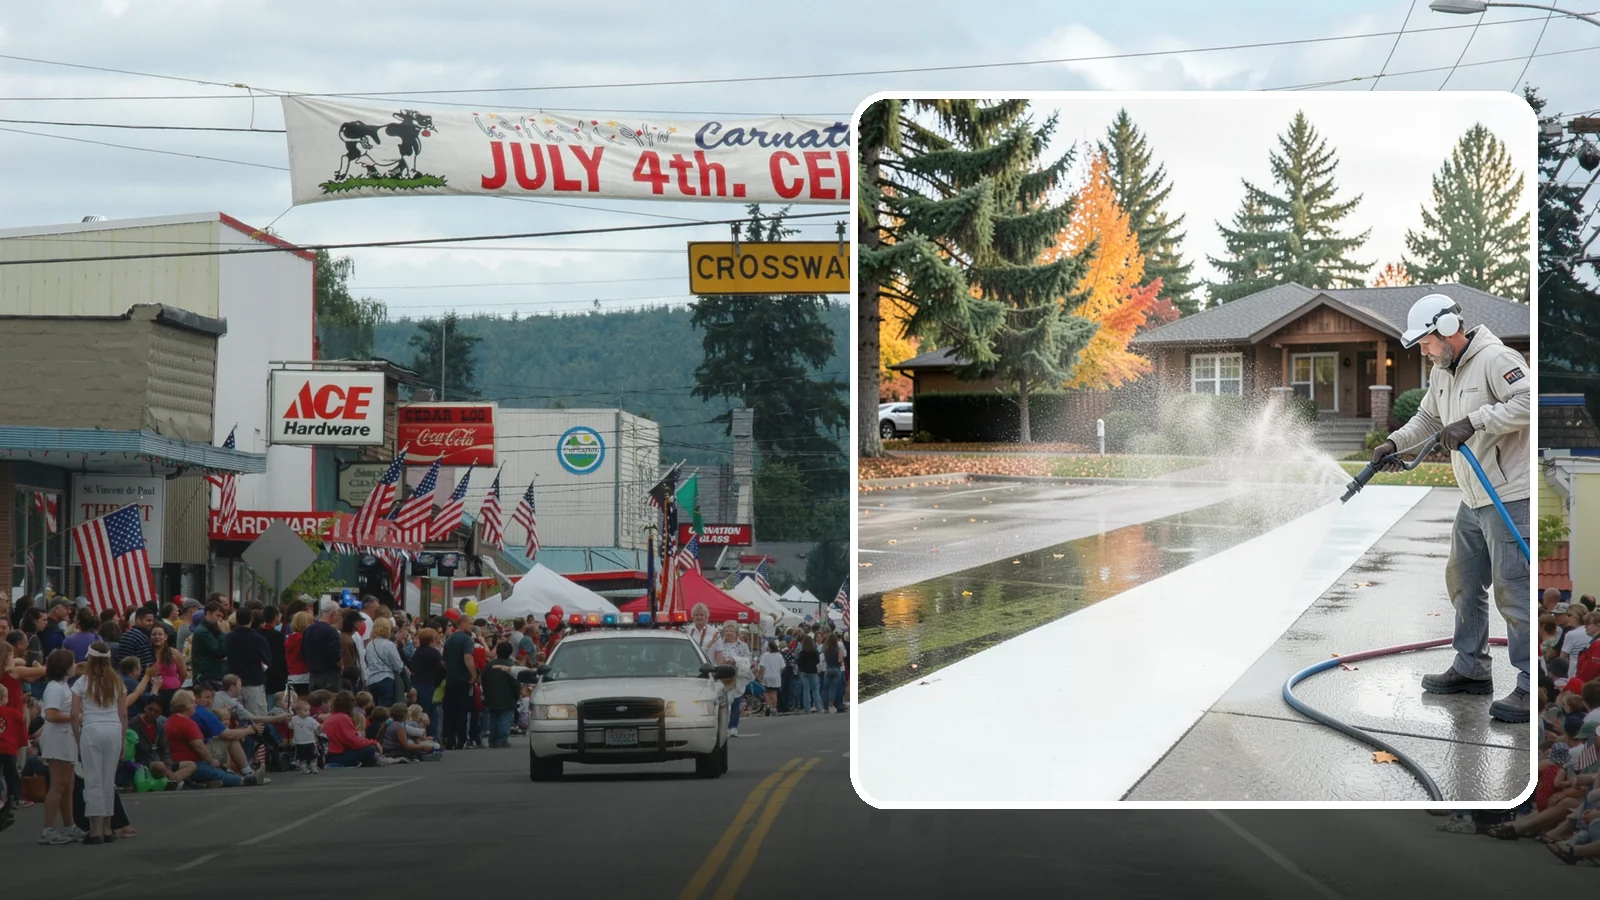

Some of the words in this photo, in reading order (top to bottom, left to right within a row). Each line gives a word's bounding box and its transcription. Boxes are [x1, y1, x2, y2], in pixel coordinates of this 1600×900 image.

[695, 121, 850, 150] Carnat
[481, 141, 605, 192] JULY
[632, 150, 746, 197] 4th.
[697, 254, 850, 280] CROSSWA
[283, 380, 373, 420] ACE
[406, 409, 452, 422] CEDAR
[283, 421, 371, 437] Hardware
[95, 485, 124, 495] Vincent
[126, 486, 136, 495] de
[137, 486, 155, 495] Paul
[688, 526, 741, 535] CRNATION
[699, 535, 730, 543] GLASS
